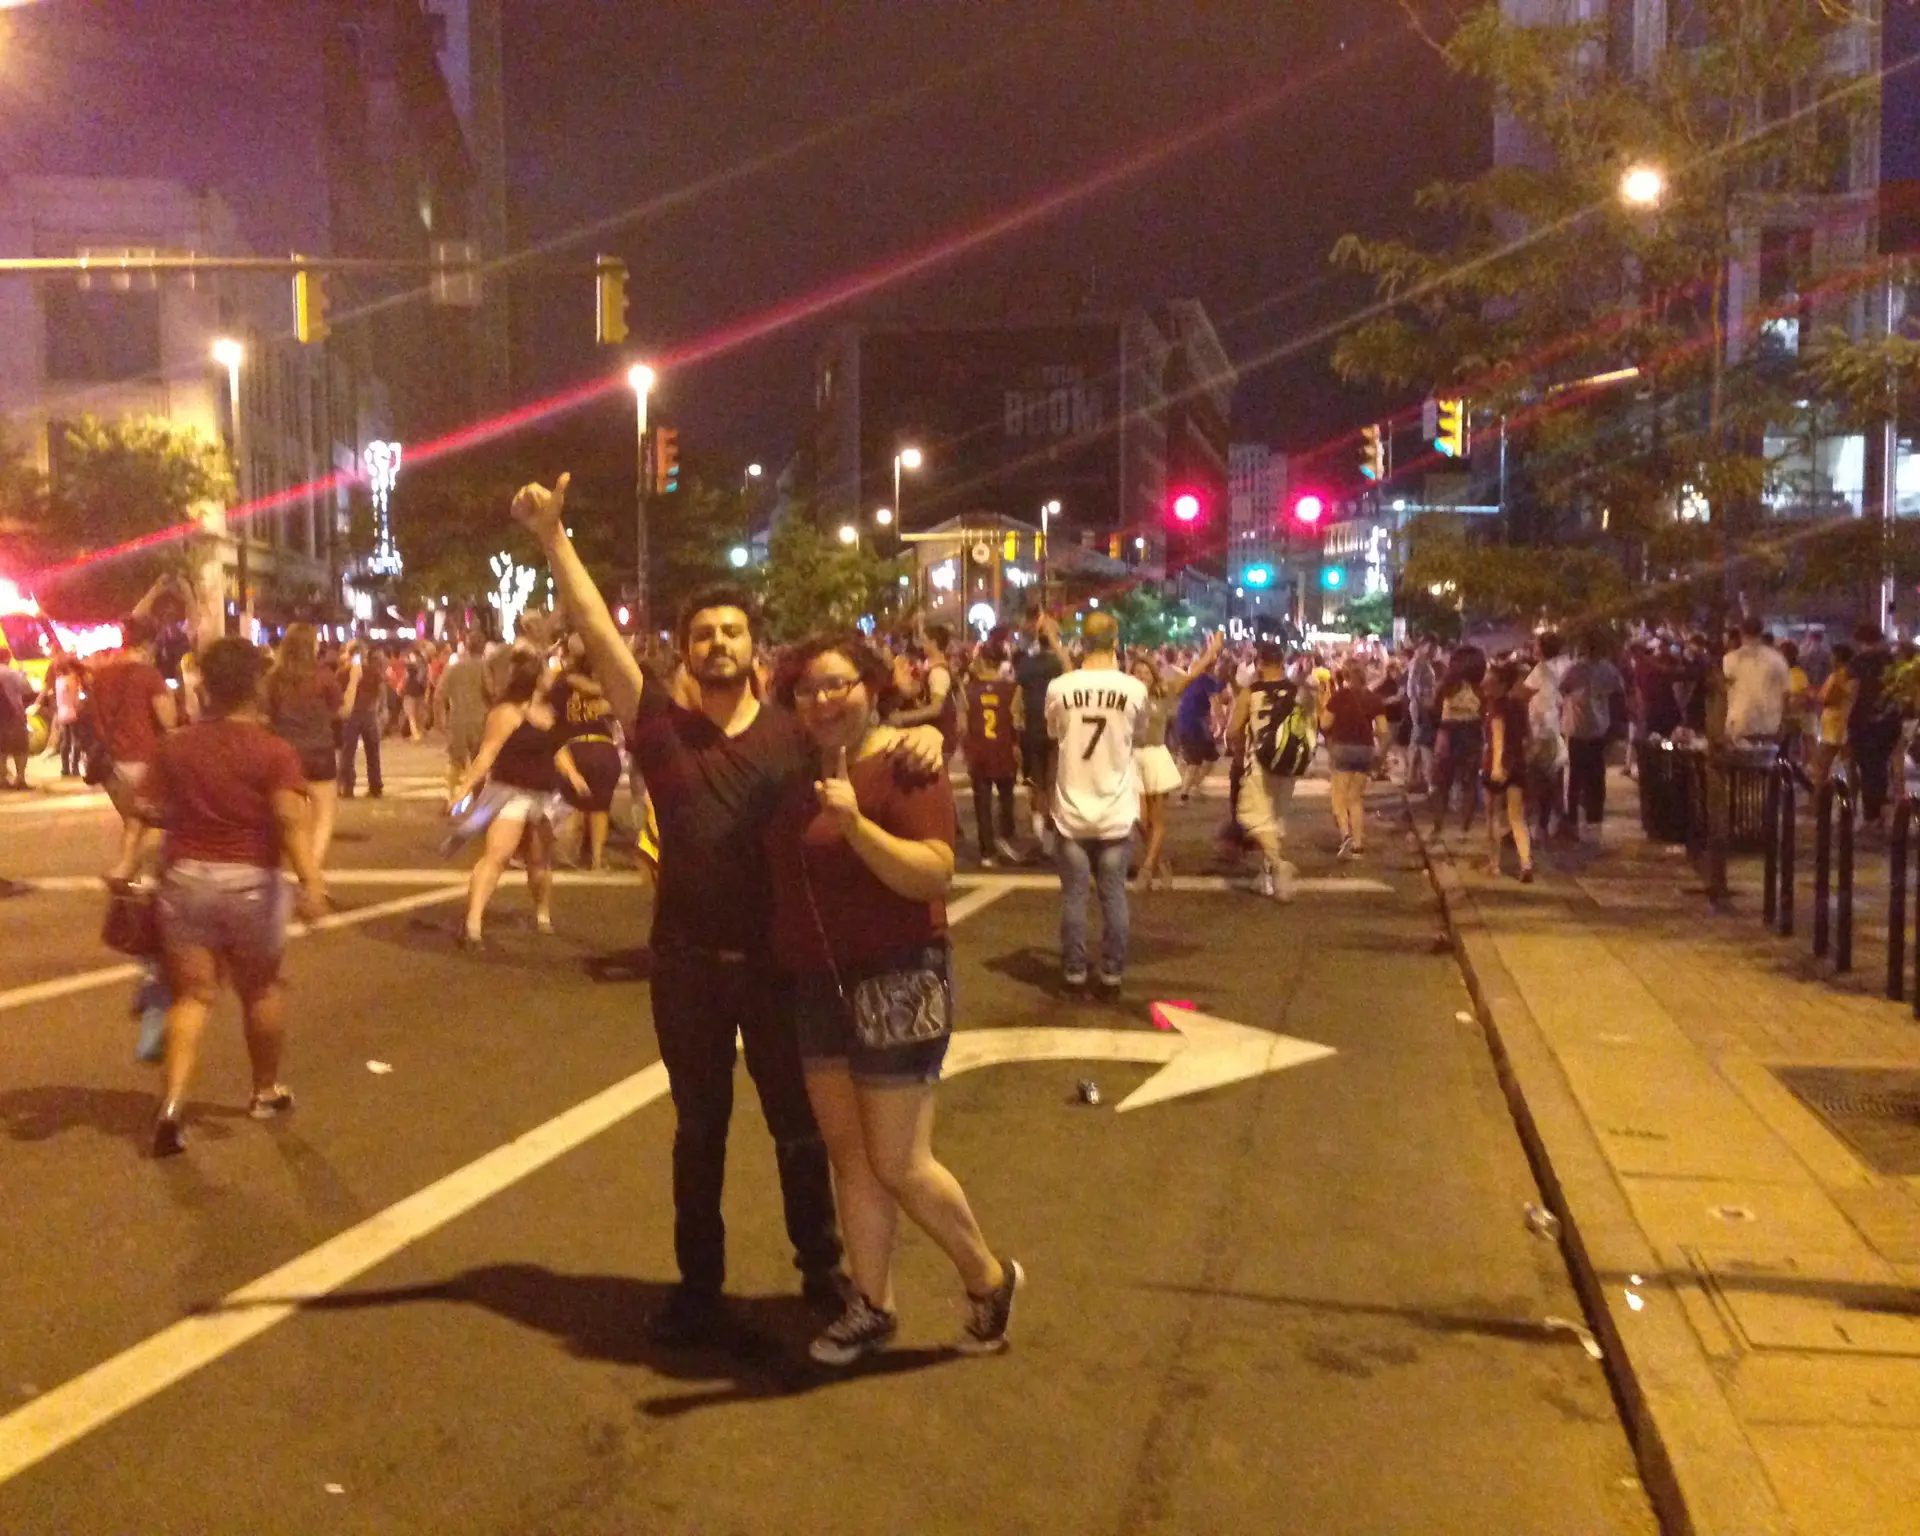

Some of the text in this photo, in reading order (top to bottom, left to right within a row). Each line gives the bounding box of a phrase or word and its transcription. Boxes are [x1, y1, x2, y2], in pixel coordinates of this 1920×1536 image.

[1062, 688, 1128, 712] LOFTON
[983, 708, 997, 739] 2
[1082, 714, 1107, 760] 7
